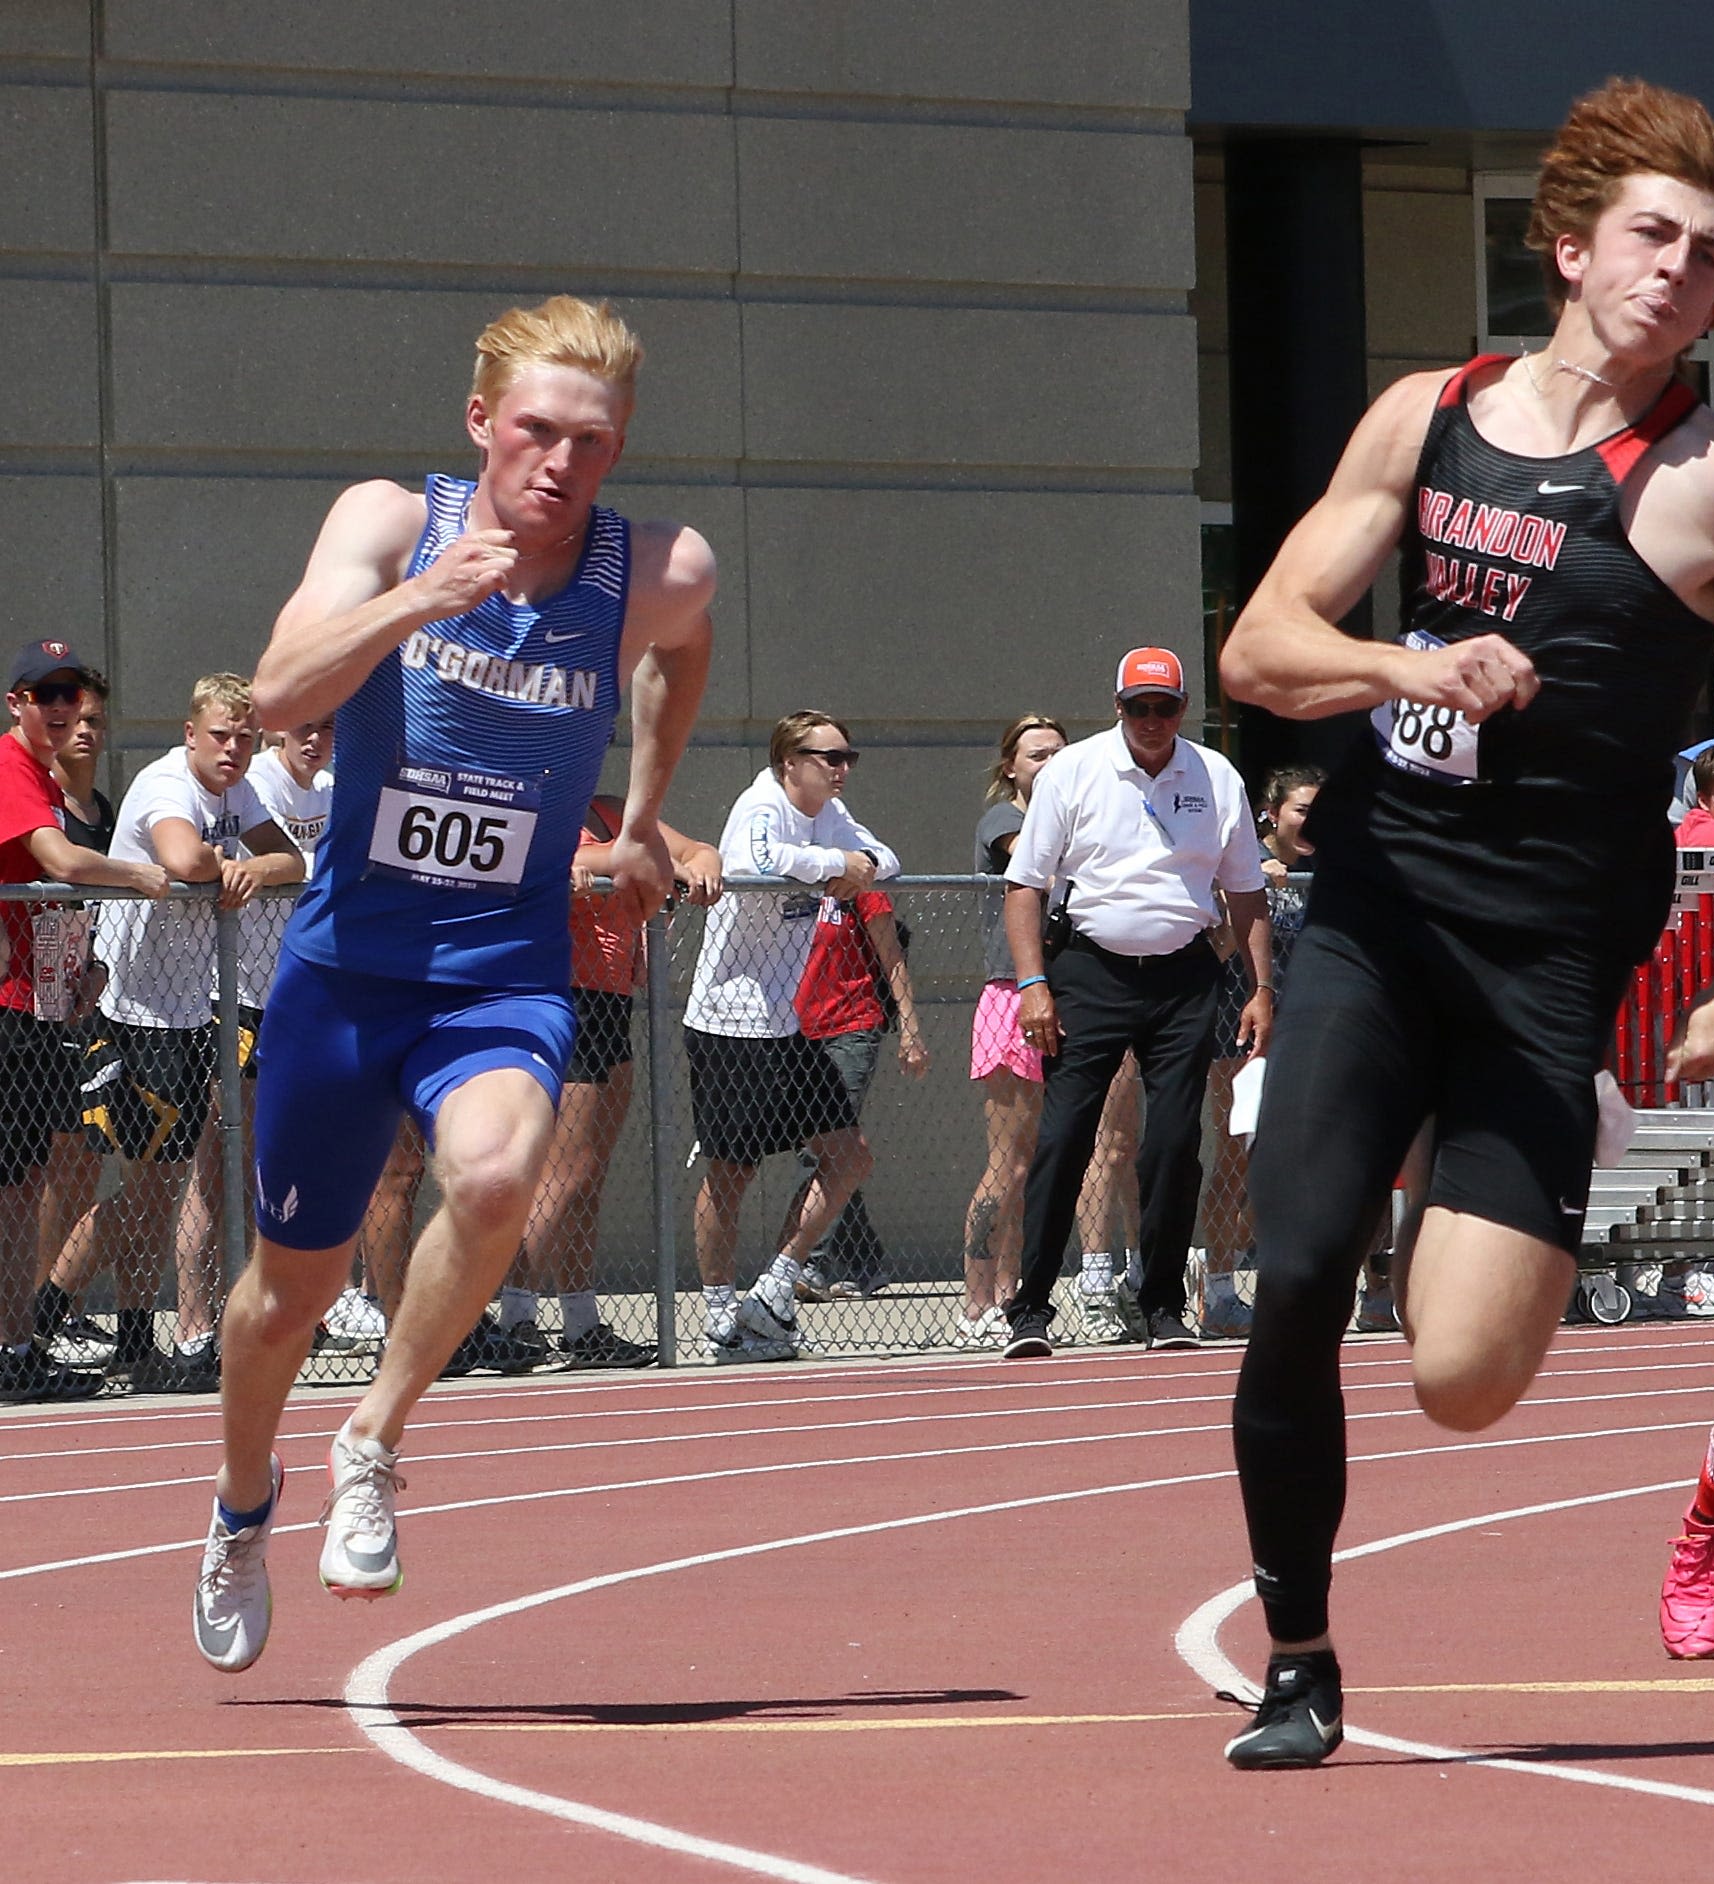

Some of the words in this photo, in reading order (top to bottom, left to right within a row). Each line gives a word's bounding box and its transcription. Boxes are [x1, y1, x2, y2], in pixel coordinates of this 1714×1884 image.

[1418, 486, 1567, 571] BRANDON
[1425, 550, 1532, 622] VALLEY
[403, 630, 598, 710] O'GORMAN
[457, 772, 483, 786] STATE
[485, 776, 515, 790] TRACK
[463, 785, 488, 798] FIELD
[489, 791, 515, 802] MEET
[398, 805, 508, 872] 605
[1681, 876, 1699, 886] GILL
